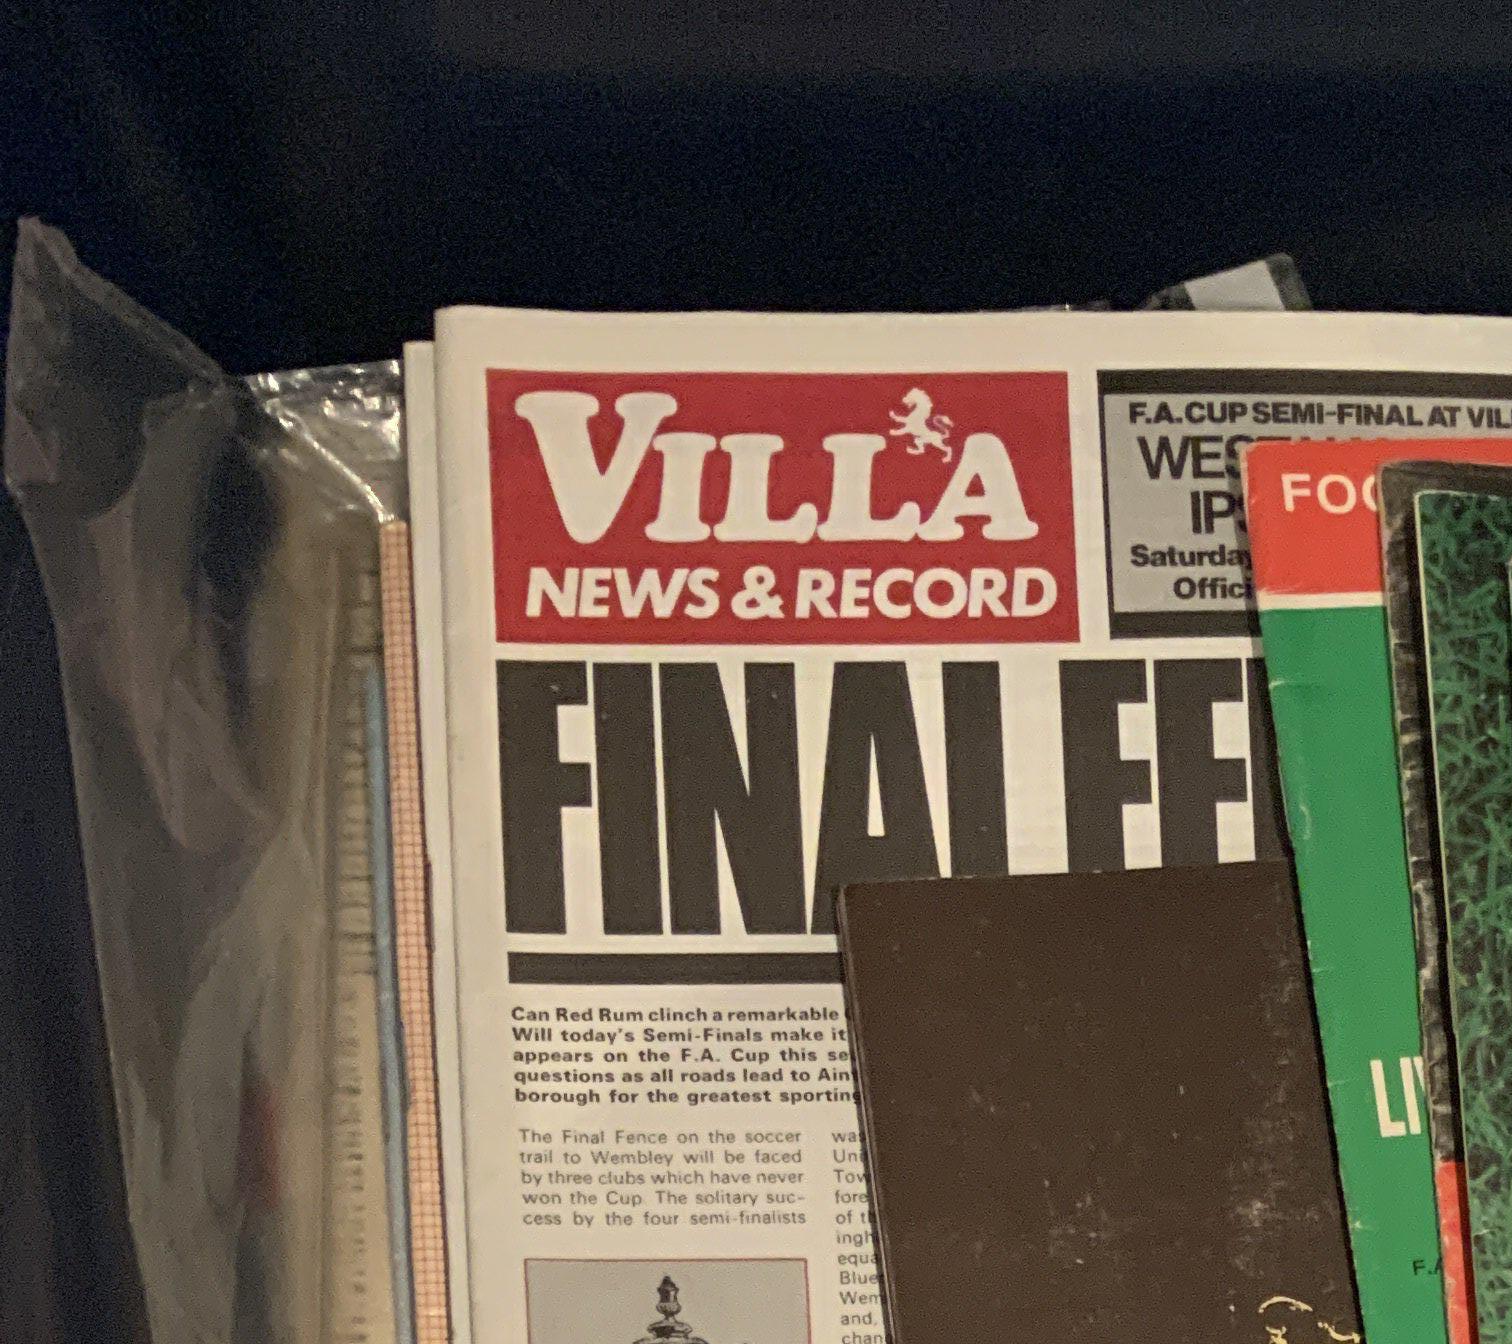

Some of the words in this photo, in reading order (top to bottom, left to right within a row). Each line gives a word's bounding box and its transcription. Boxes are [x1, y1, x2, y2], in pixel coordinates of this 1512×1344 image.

[1129, 401, 1247, 424] F.A.CUP
[1252, 402, 1424, 427] SEMI-FINAL
[1427, 406, 1462, 427] AT
[515, 390, 1039, 545] VILLA
[526, 567, 720, 619] NEWS
[732, 566, 790, 619] &
[796, 567, 1057, 620] RECORD
[511, 1006, 550, 1021] Can
[556, 1008, 593, 1022] Red
[599, 1008, 643, 1022] Rum
[648, 1007, 707, 1022] clinch
[713, 1011, 722, 1021] a
[727, 1007, 839, 1021] remarkable
[512, 1027, 552, 1041] Will
[560, 1028, 635, 1045] today's
[643, 1028, 763, 1042] Semi-Finals
[770, 1027, 824, 1041] make
[513, 1051, 593, 1064] appears
[603, 1052, 628, 1063] on
[638, 1048, 670, 1062] the
[681, 1048, 720, 1062] F.A.
[730, 1047, 769, 1064] Cup
[779, 1047, 817, 1062] this
[514, 1069, 615, 1085] questions
[622, 1073, 643, 1082] as
[651, 1069, 673, 1082] all
[681, 1069, 735, 1082] roads
[743, 1068, 783, 1082] lead
[790, 1070, 810, 1081] to
[515, 1088, 600, 1106] borough
[609, 1089, 638, 1103] for
[647, 1089, 679, 1103] the
[687, 1090, 771, 1106] greatest
[518, 1128, 552, 1143] The
[562, 1129, 604, 1144] Final
[615, 1129, 667, 1144] Fence
[677, 1133, 699, 1144] on
[708, 1130, 735, 1143] the
[745, 1132, 801, 1143] soccer
